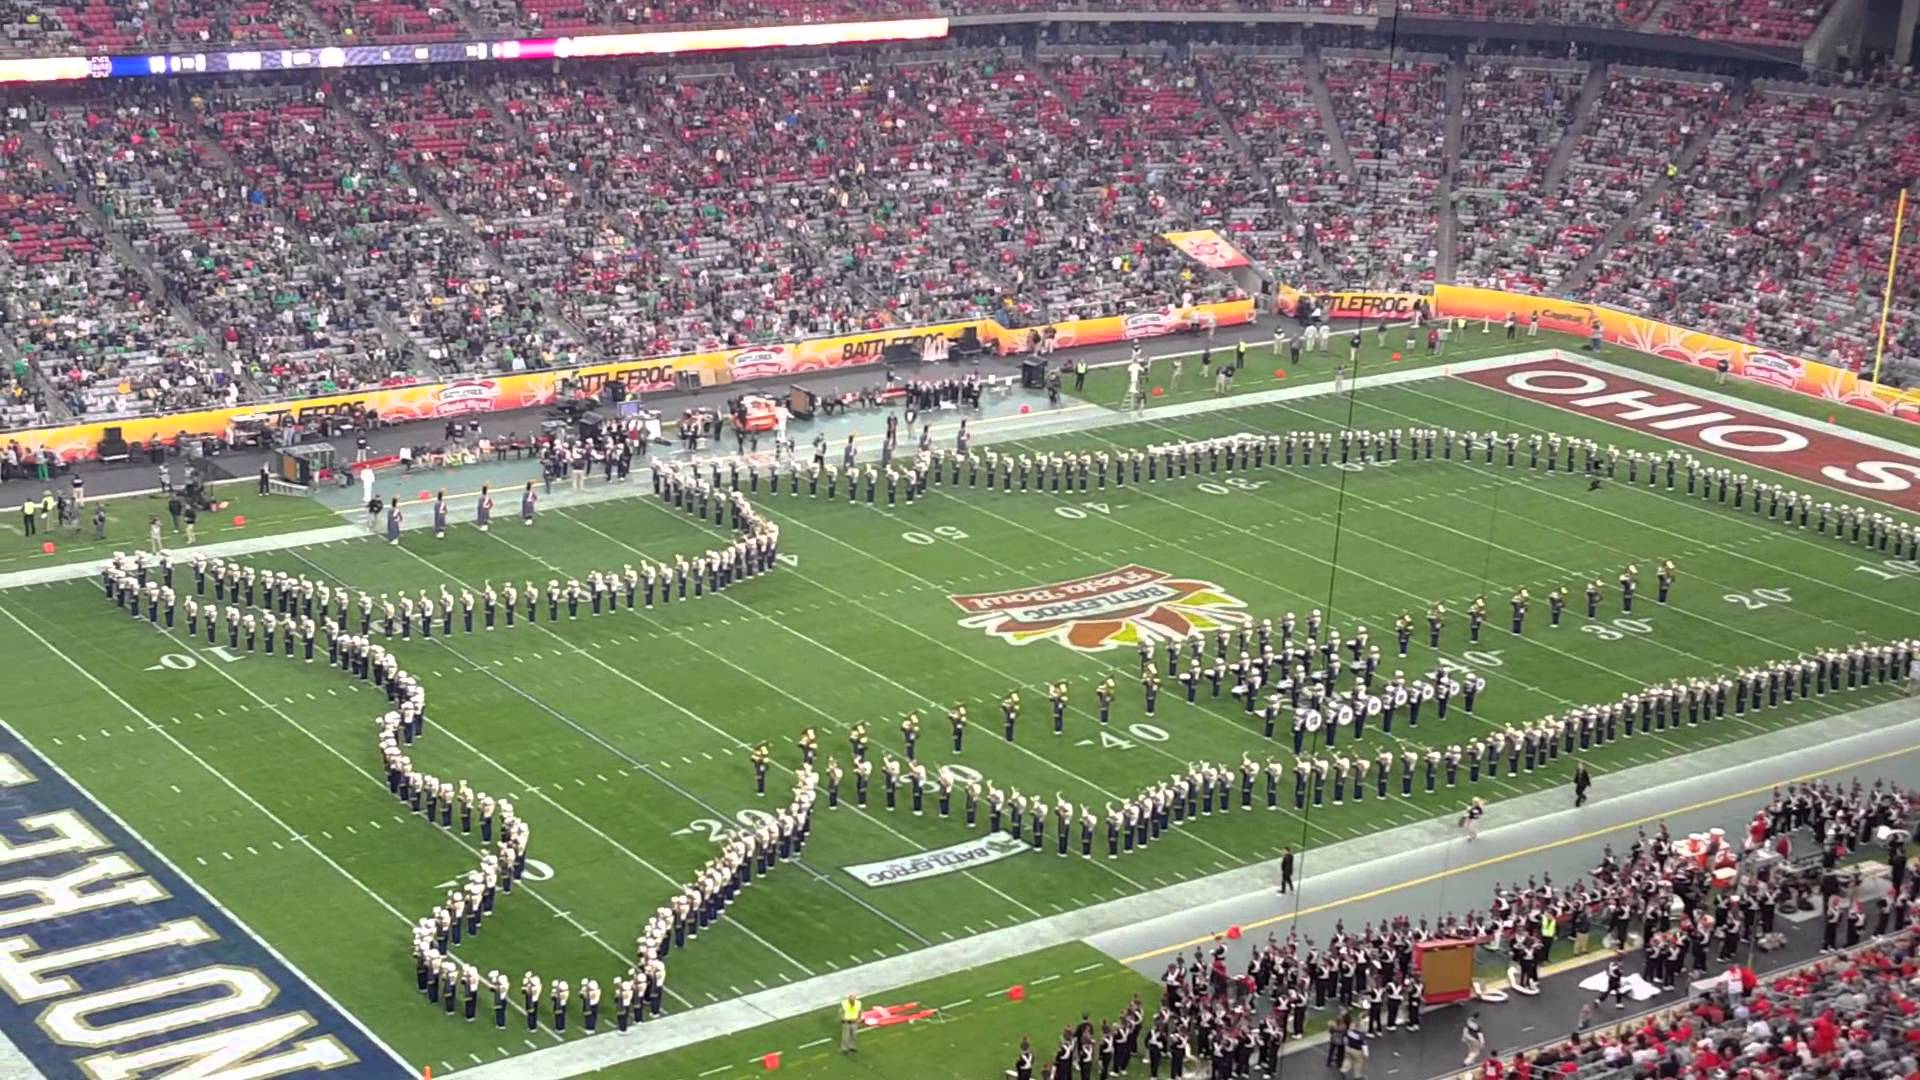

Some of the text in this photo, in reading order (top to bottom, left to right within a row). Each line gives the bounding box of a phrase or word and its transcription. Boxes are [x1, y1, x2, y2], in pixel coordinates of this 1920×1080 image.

[1506, 370, 1810, 453] OHIO
[1198, 477, 1263, 495] 30
[1054, 501, 1112, 520] 40
[902, 525, 969, 545] 50
[968, 571, 1151, 609] Fiesta Bowl
[1023, 586, 1166, 619] BATTLEFROG
[1723, 588, 1792, 610] 20
[1581, 617, 1653, 641] 30
[1100, 723, 1170, 750] 40
[867, 847, 989, 883] BATTLEFROG
